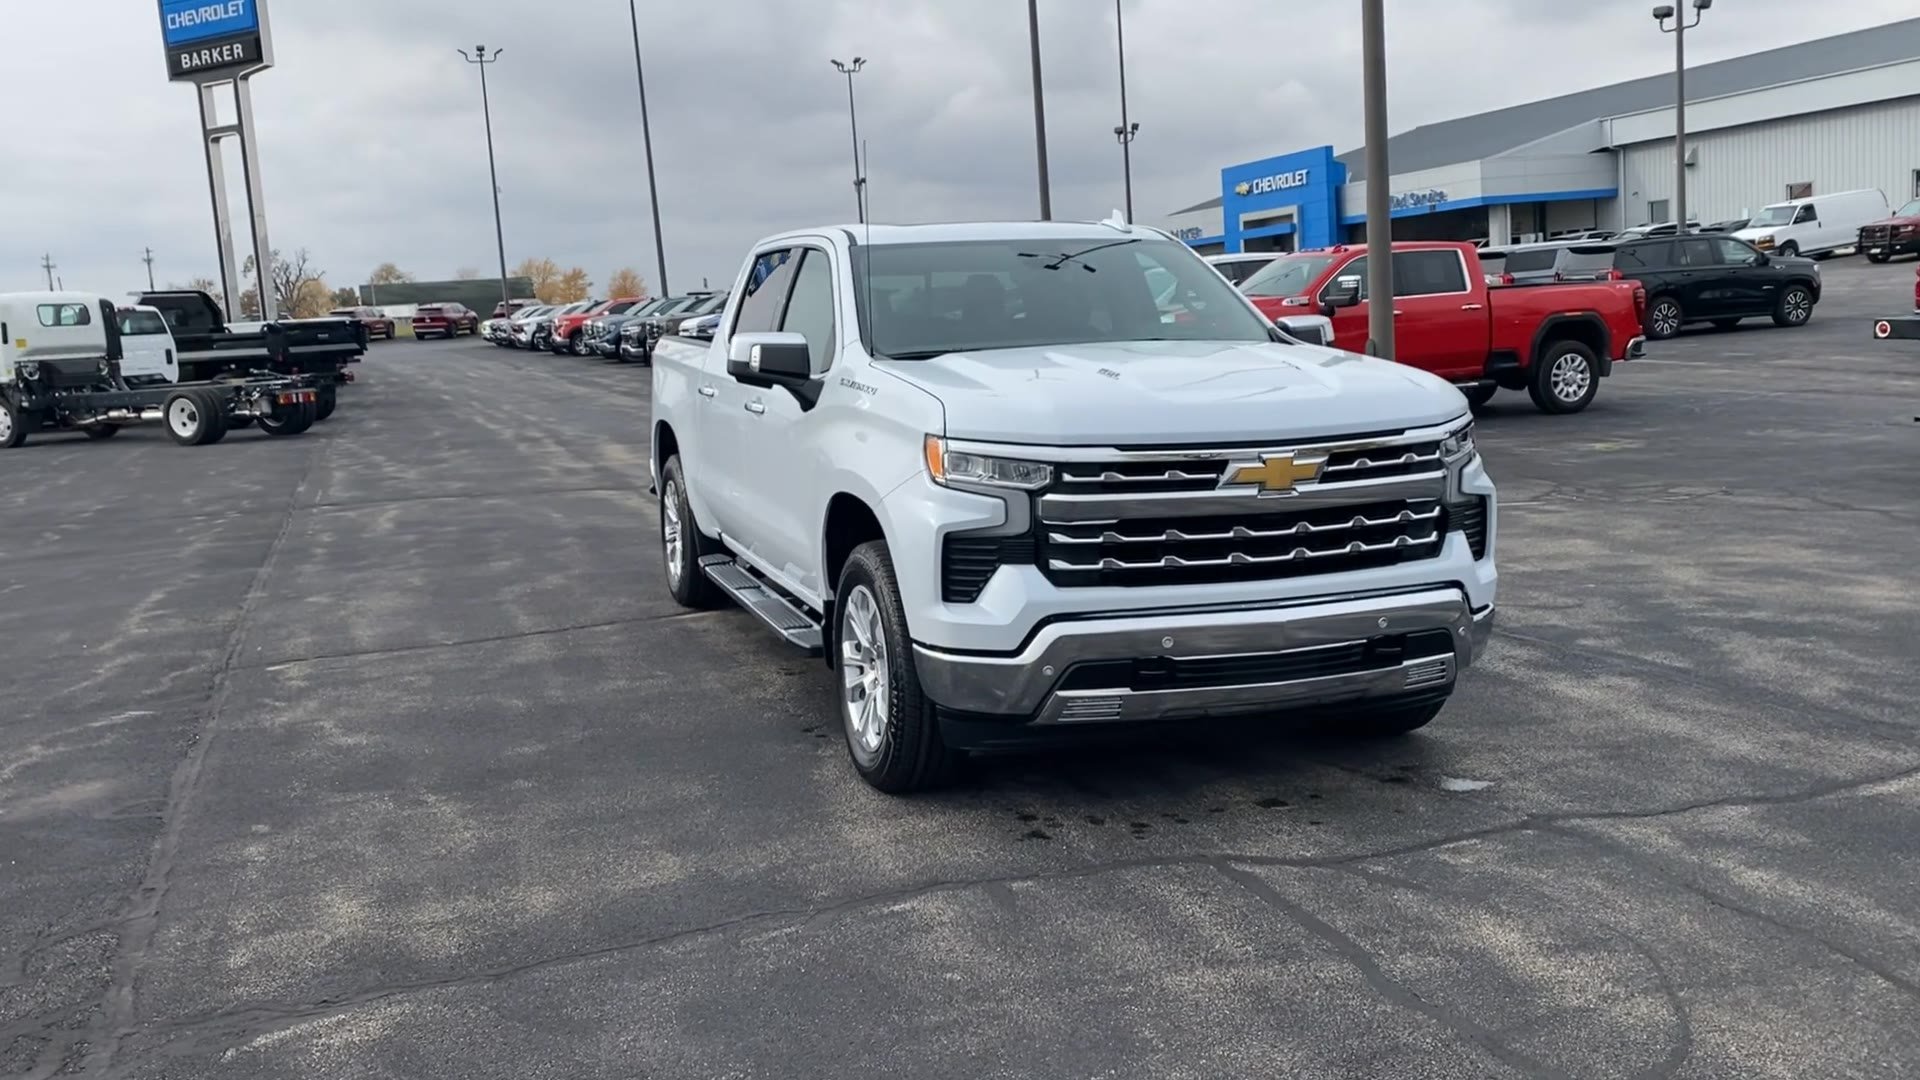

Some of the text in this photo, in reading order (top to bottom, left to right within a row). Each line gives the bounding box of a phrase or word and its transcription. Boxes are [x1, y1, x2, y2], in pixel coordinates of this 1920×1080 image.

[167, 0, 245, 30] CHEVROLET
[181, 43, 244, 69] BARKER
[1253, 169, 1308, 194] CHEVROLET
